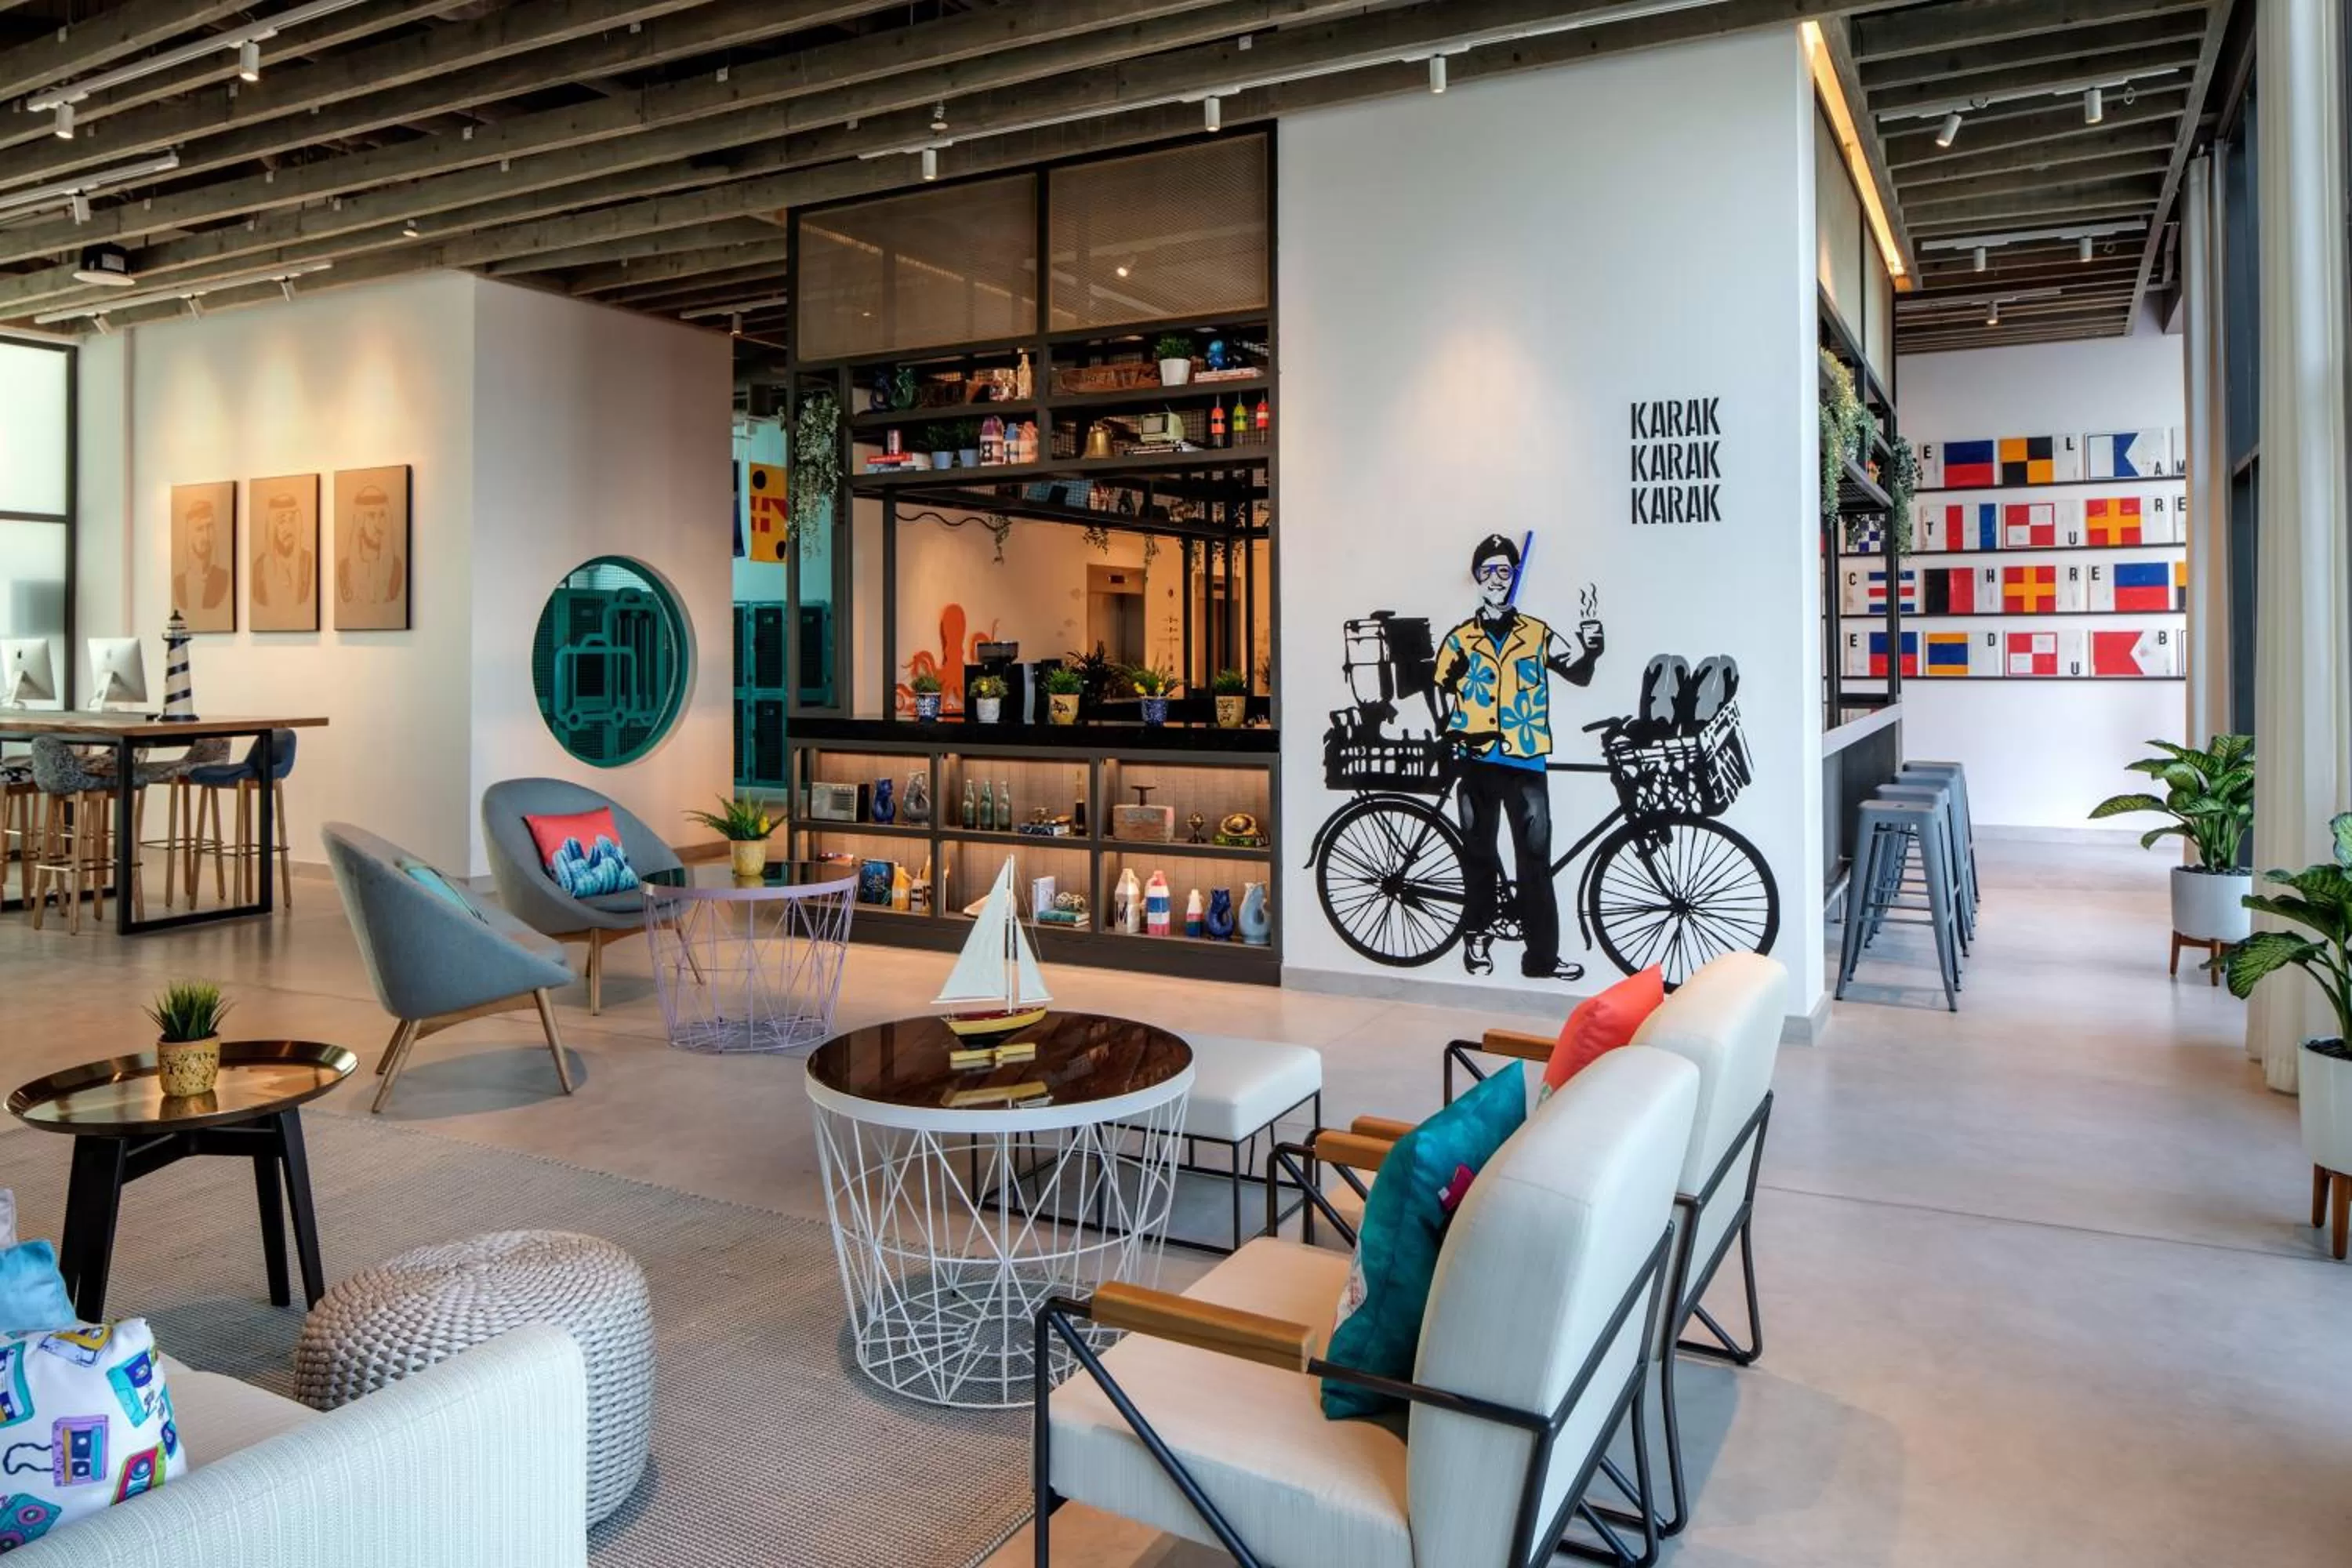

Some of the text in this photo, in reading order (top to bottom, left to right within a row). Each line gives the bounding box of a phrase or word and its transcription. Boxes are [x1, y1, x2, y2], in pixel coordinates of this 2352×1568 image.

[1631, 397, 1721, 439] KARAK
[1631, 441, 1721, 481] KARAK
[1923, 445, 1932, 459] E
[2065, 437, 2074, 451] L
[2154, 461, 2162, 475] A
[1632, 484, 1721, 524] KARAK
[1926, 521, 1934, 535] T
[2068, 531, 2078, 545] U
[2154, 498, 2163, 511] R
[2177, 496, 2186, 511] E
[1848, 572, 1857, 586] C
[2091, 565, 2100, 581] E
[1849, 630, 2167, 675] E D U B
